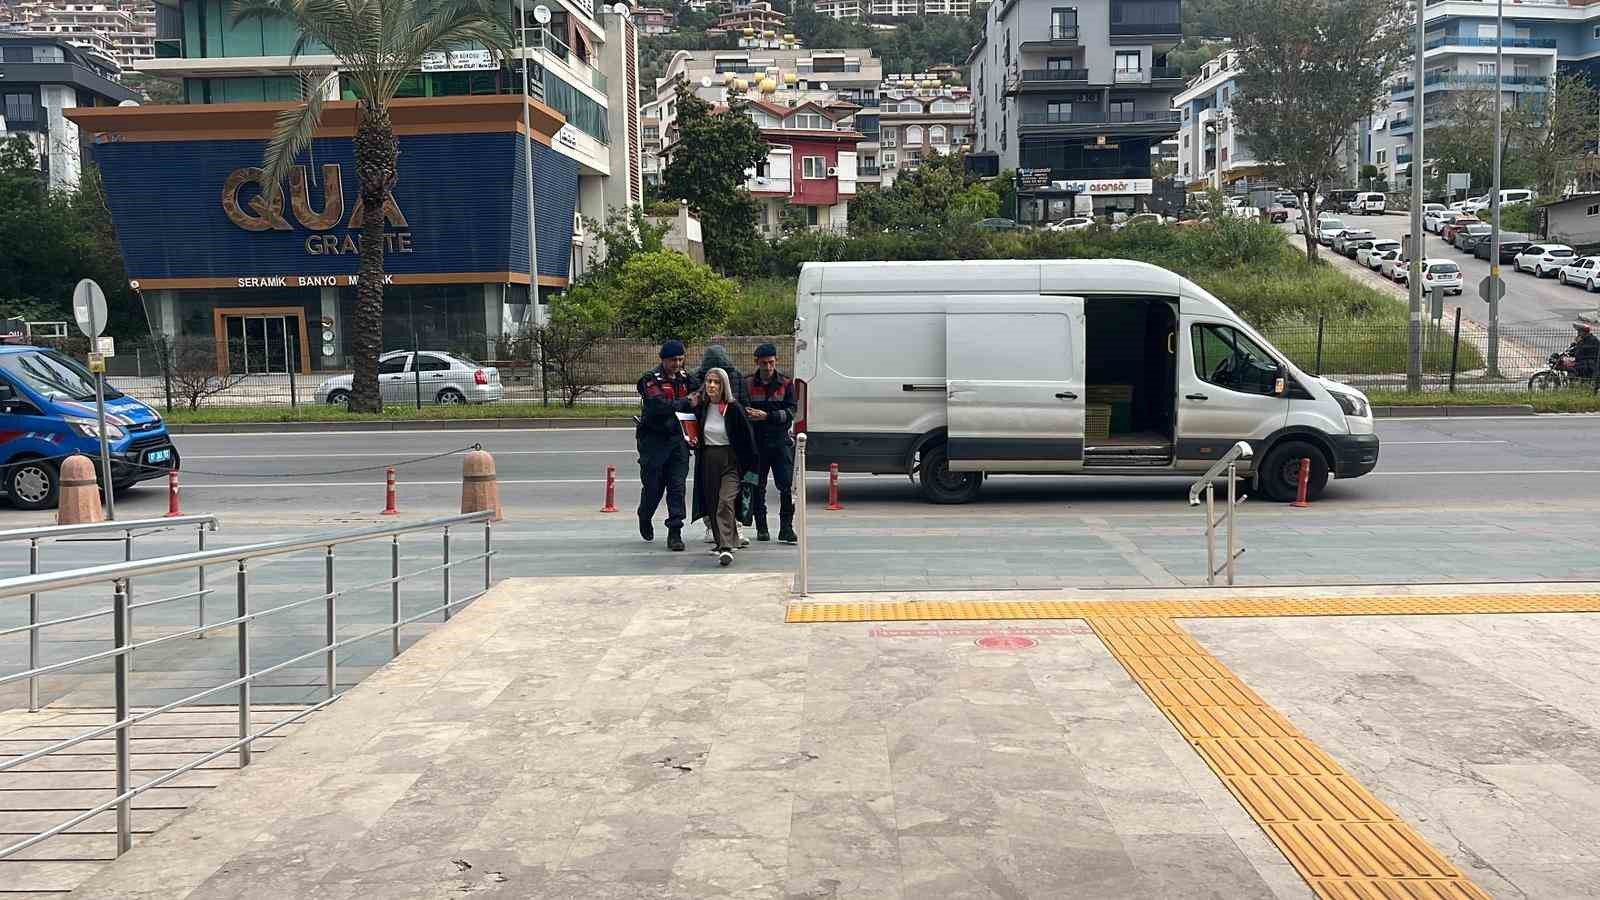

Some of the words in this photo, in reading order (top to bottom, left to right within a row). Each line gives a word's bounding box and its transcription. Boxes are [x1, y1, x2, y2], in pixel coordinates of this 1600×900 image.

[1066, 182, 1087, 193] bilgi
[1089, 181, 1128, 192] asansör
[304, 233, 414, 255] GRATE
[238, 275, 287, 288] SERAMİK
[298, 275, 337, 287] BANYO
